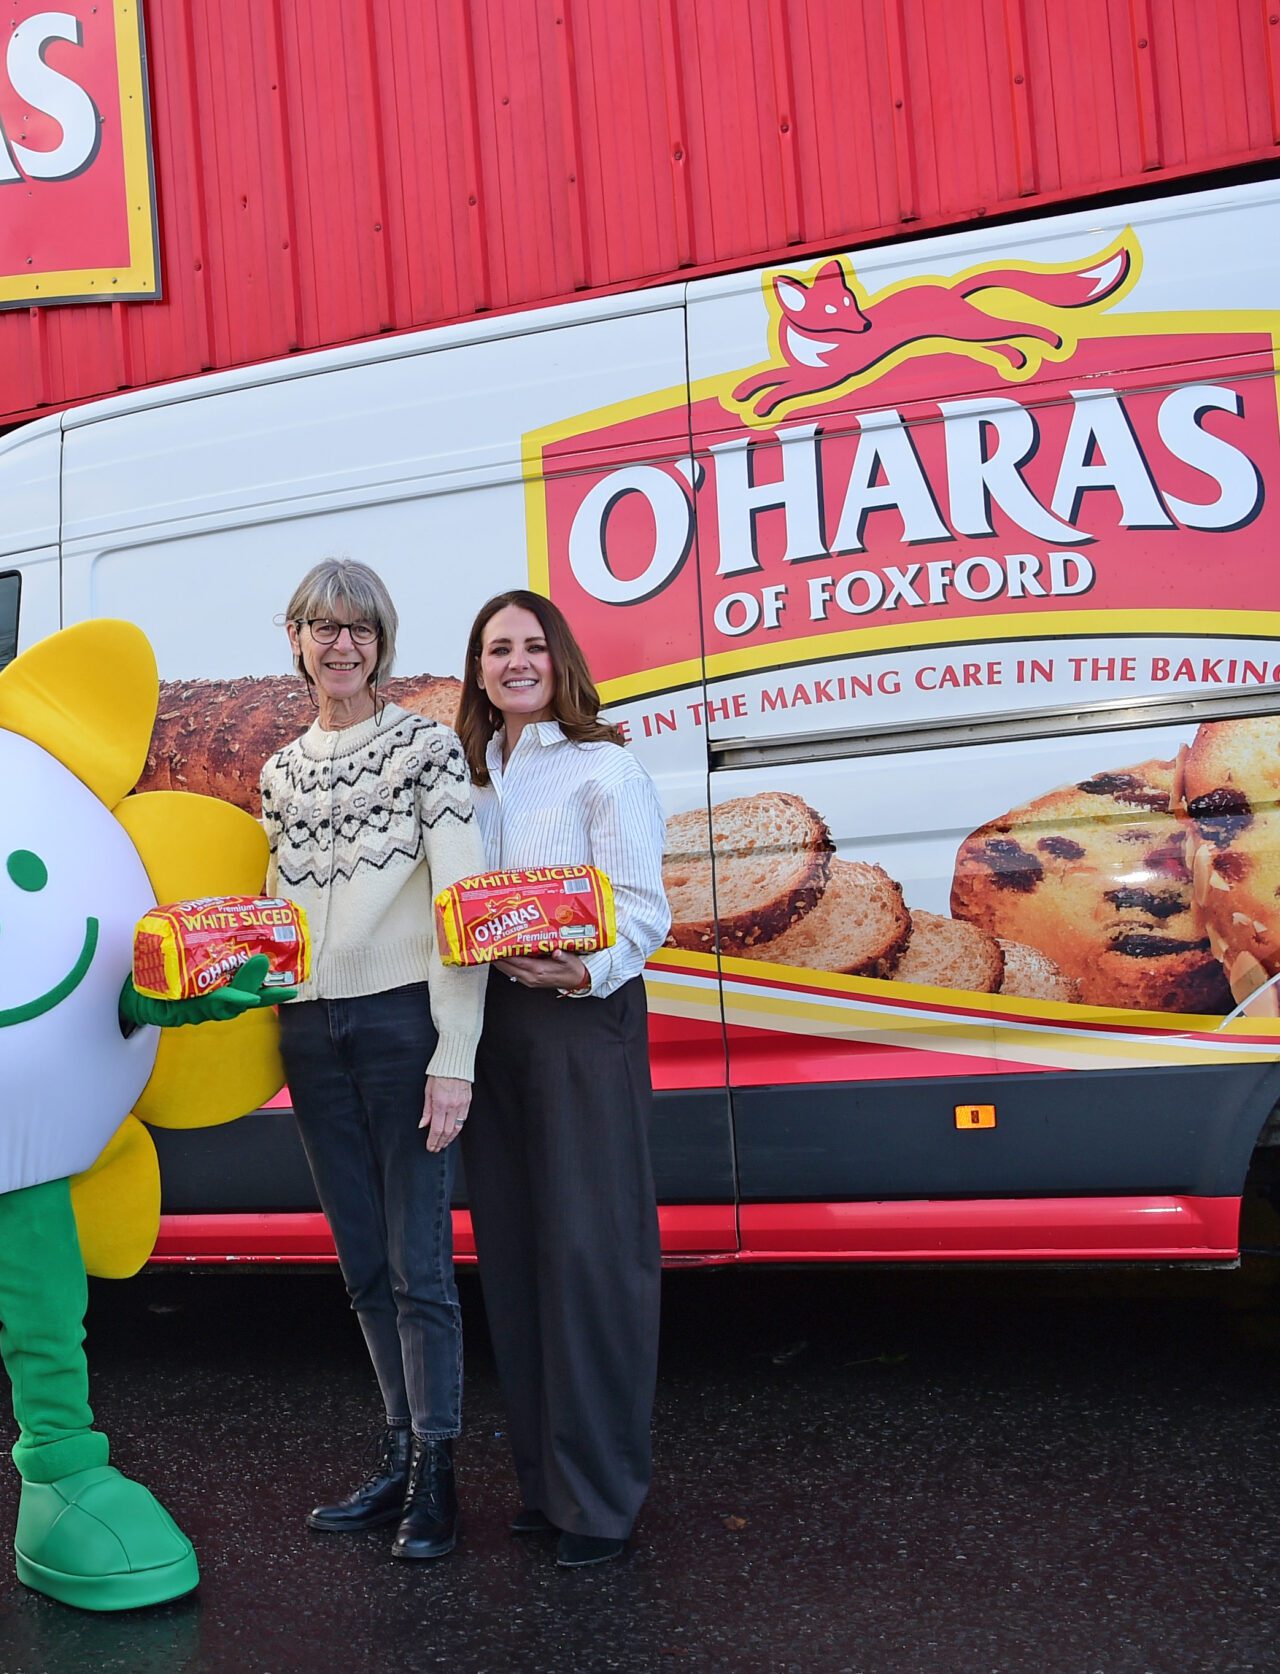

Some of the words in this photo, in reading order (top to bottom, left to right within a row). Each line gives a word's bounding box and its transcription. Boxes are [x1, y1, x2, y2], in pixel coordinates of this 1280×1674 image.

[568, 385, 1261, 604] O'HARAS
[713, 584, 786, 636] OF
[808, 551, 1095, 621] FOXFORD
[642, 709, 677, 737] IN
[686, 693, 748, 726] THE
[760, 670, 902, 713] MAKING
[914, 661, 1003, 691] CARE
[1016, 658, 1055, 683] IN
[1068, 657, 1138, 682] THE
[459, 874, 522, 891] WHITE
[525, 865, 588, 883] SLICED
[180, 913, 239, 932] WHITE
[242, 909, 293, 926] SLICED
[218, 903, 255, 913] Premium
[474, 904, 540, 942] O'HARAS
[516, 929, 558, 942] Premium
